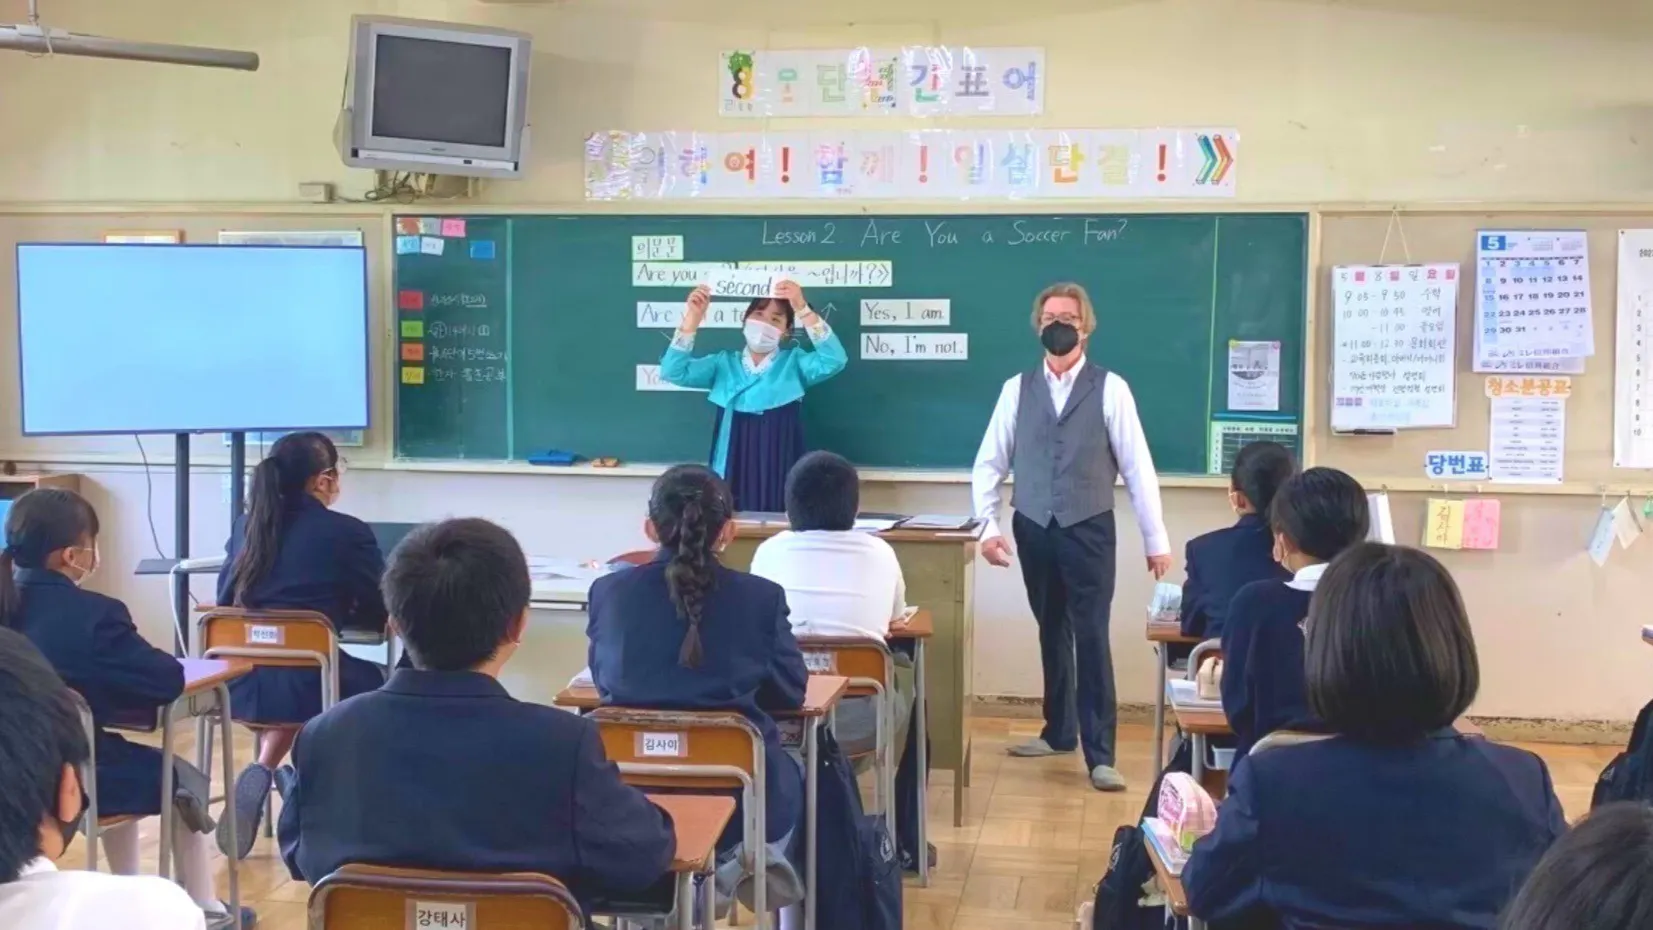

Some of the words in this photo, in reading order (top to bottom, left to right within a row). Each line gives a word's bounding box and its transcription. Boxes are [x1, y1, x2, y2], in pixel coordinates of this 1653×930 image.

[762, 220, 817, 245] Lesson
[820, 222, 836, 245] 2
[861, 218, 901, 247] Are
[924, 219, 958, 245] You
[982, 229, 994, 244] a
[1007, 219, 1071, 246] Soccer
[1084, 218, 1128, 245] Fan?
[636, 237, 677, 259] 의문문
[1487, 236, 1500, 250] 5
[637, 263, 666, 282] Are
[673, 267, 697, 286] you
[715, 276, 772, 295] second
[641, 303, 673, 322] Are
[864, 302, 898, 322] Yes,
[904, 302, 913, 320] I
[865, 336, 895, 356] No,
[904, 335, 927, 354] I'm
[934, 335, 964, 355] not.
[1427, 454, 1486, 475] 당번표
[645, 738, 677, 751] 김사이
[418, 909, 466, 928] 강태사
